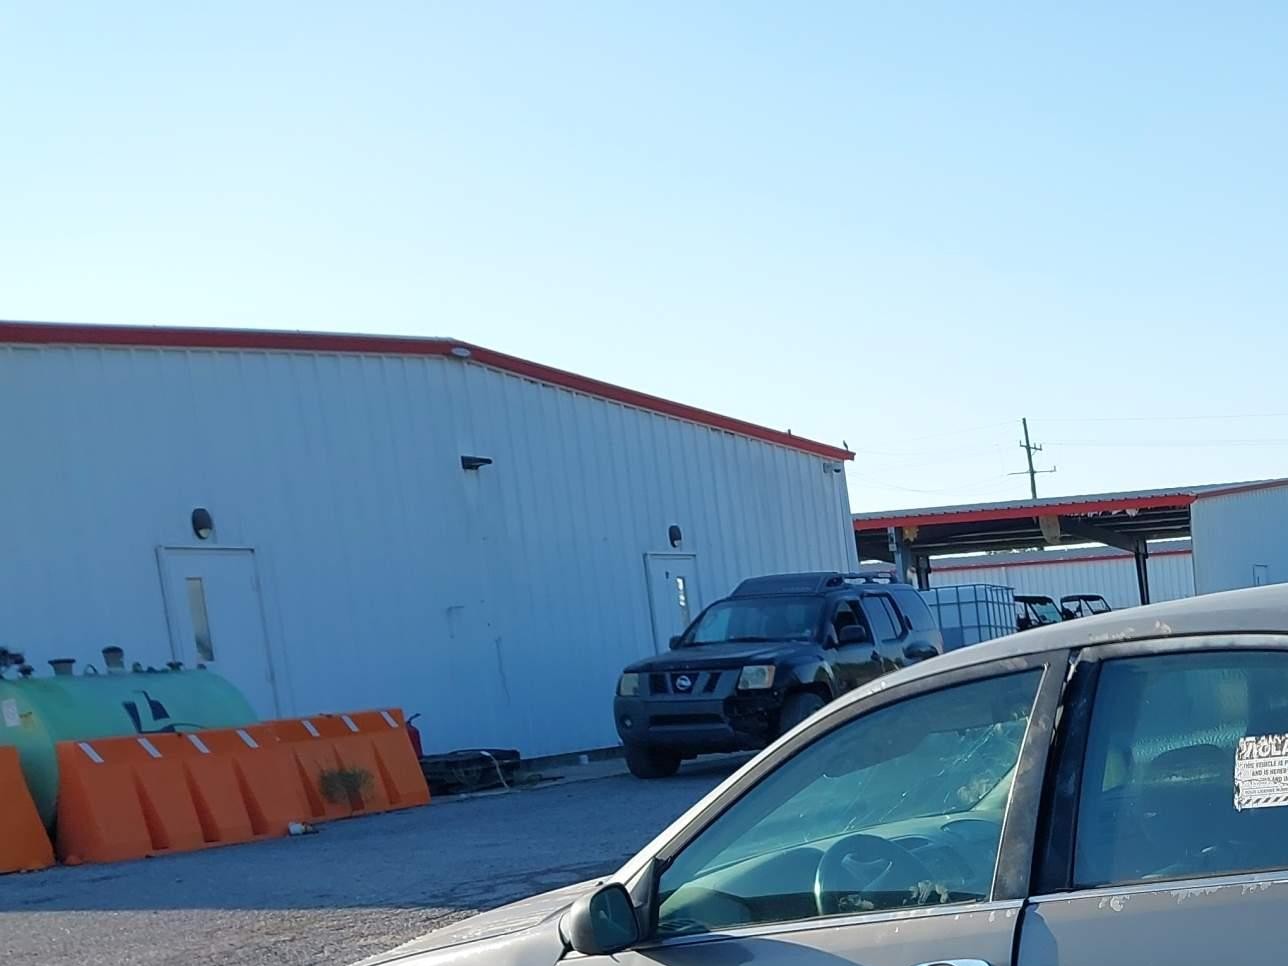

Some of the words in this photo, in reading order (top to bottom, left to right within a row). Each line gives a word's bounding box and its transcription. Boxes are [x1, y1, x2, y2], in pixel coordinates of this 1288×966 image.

[1243, 761, 1254, 769] THIS
[1256, 759, 1276, 768] VEHICLE
[1251, 769, 1263, 777] AND
